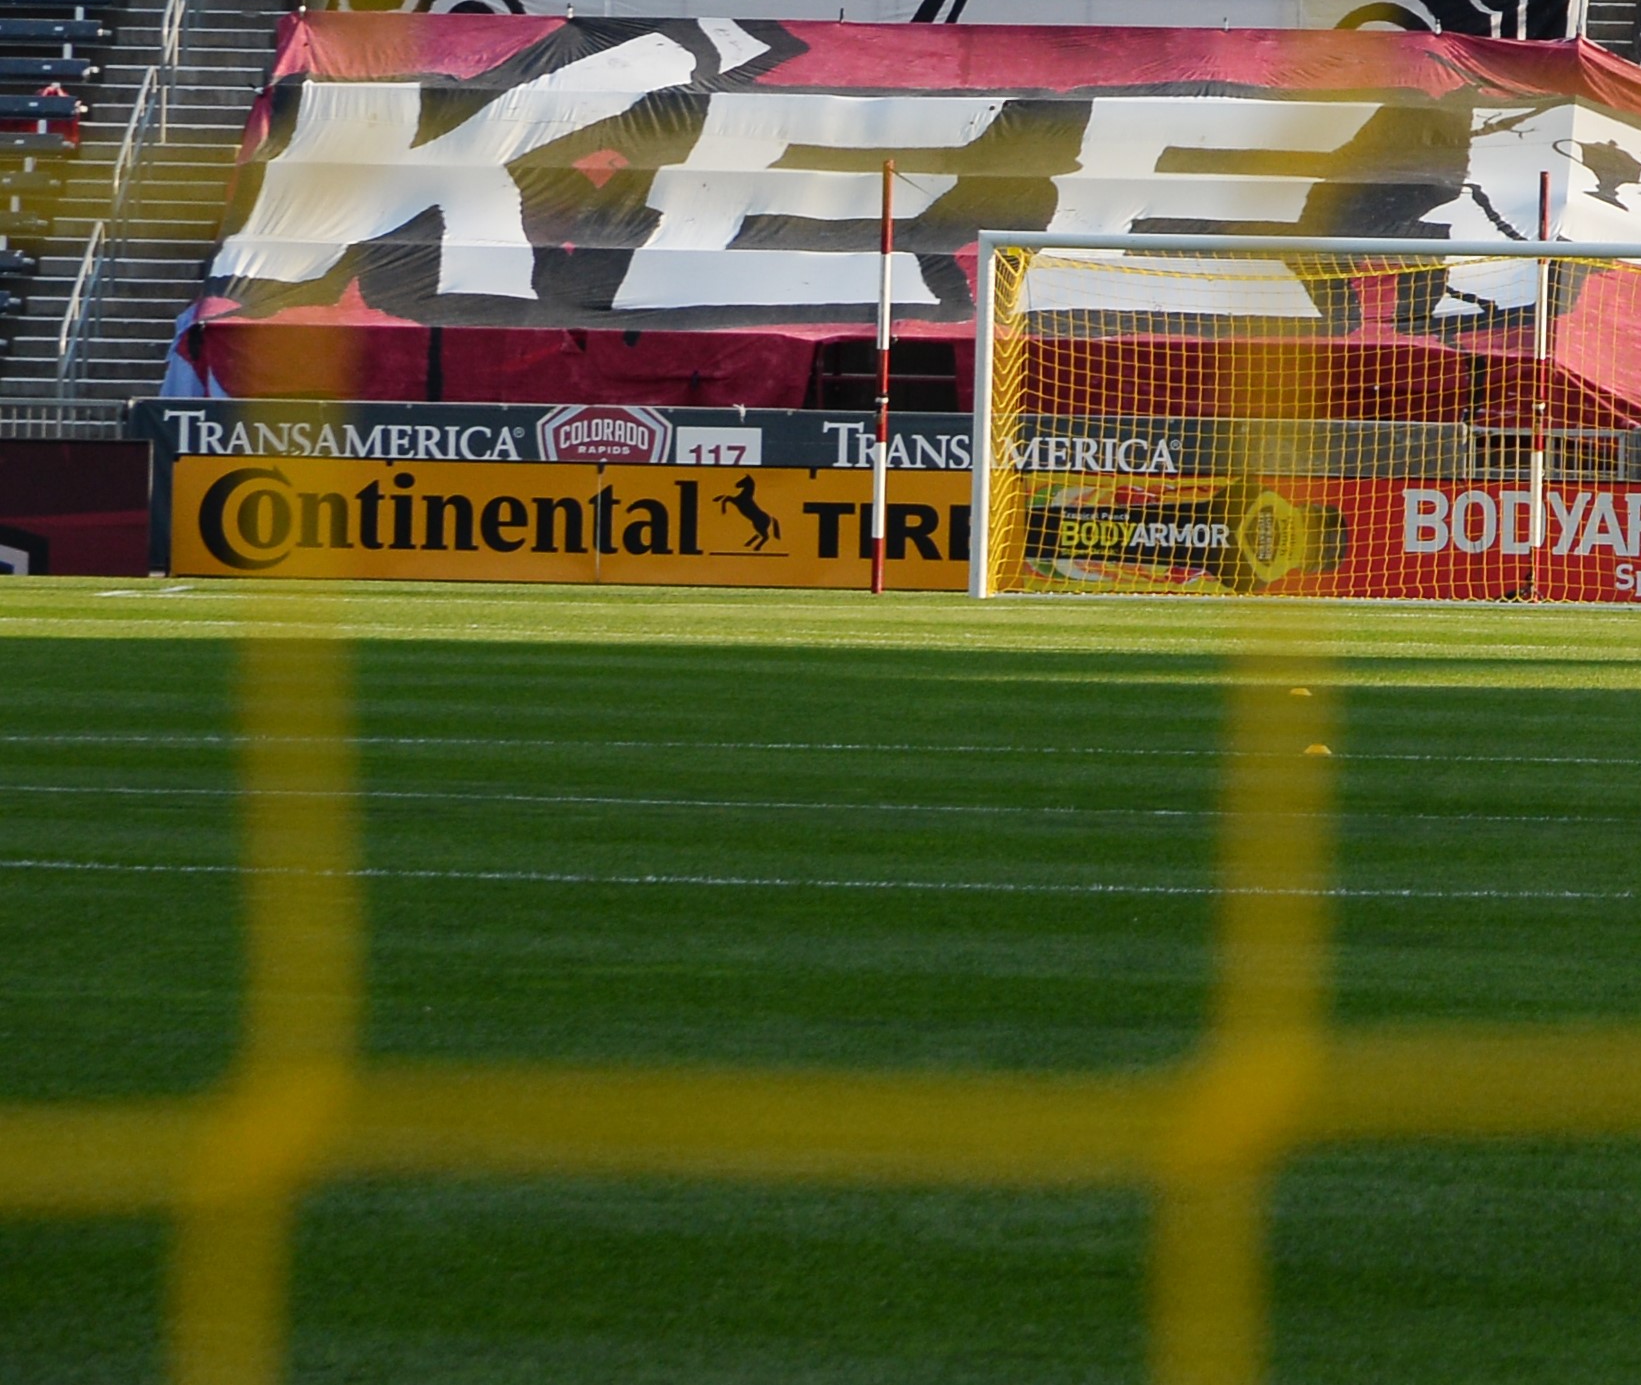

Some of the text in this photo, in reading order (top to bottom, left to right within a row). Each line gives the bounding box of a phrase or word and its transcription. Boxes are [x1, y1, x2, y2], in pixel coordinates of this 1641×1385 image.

[559, 419, 649, 450] COLORADO
[577, 445, 630, 455] RAPIDS
[823, 421, 1179, 474] TRANSMERICA
[199, 466, 702, 570] Continental
[1060, 520, 1231, 549] BODYARMOR
